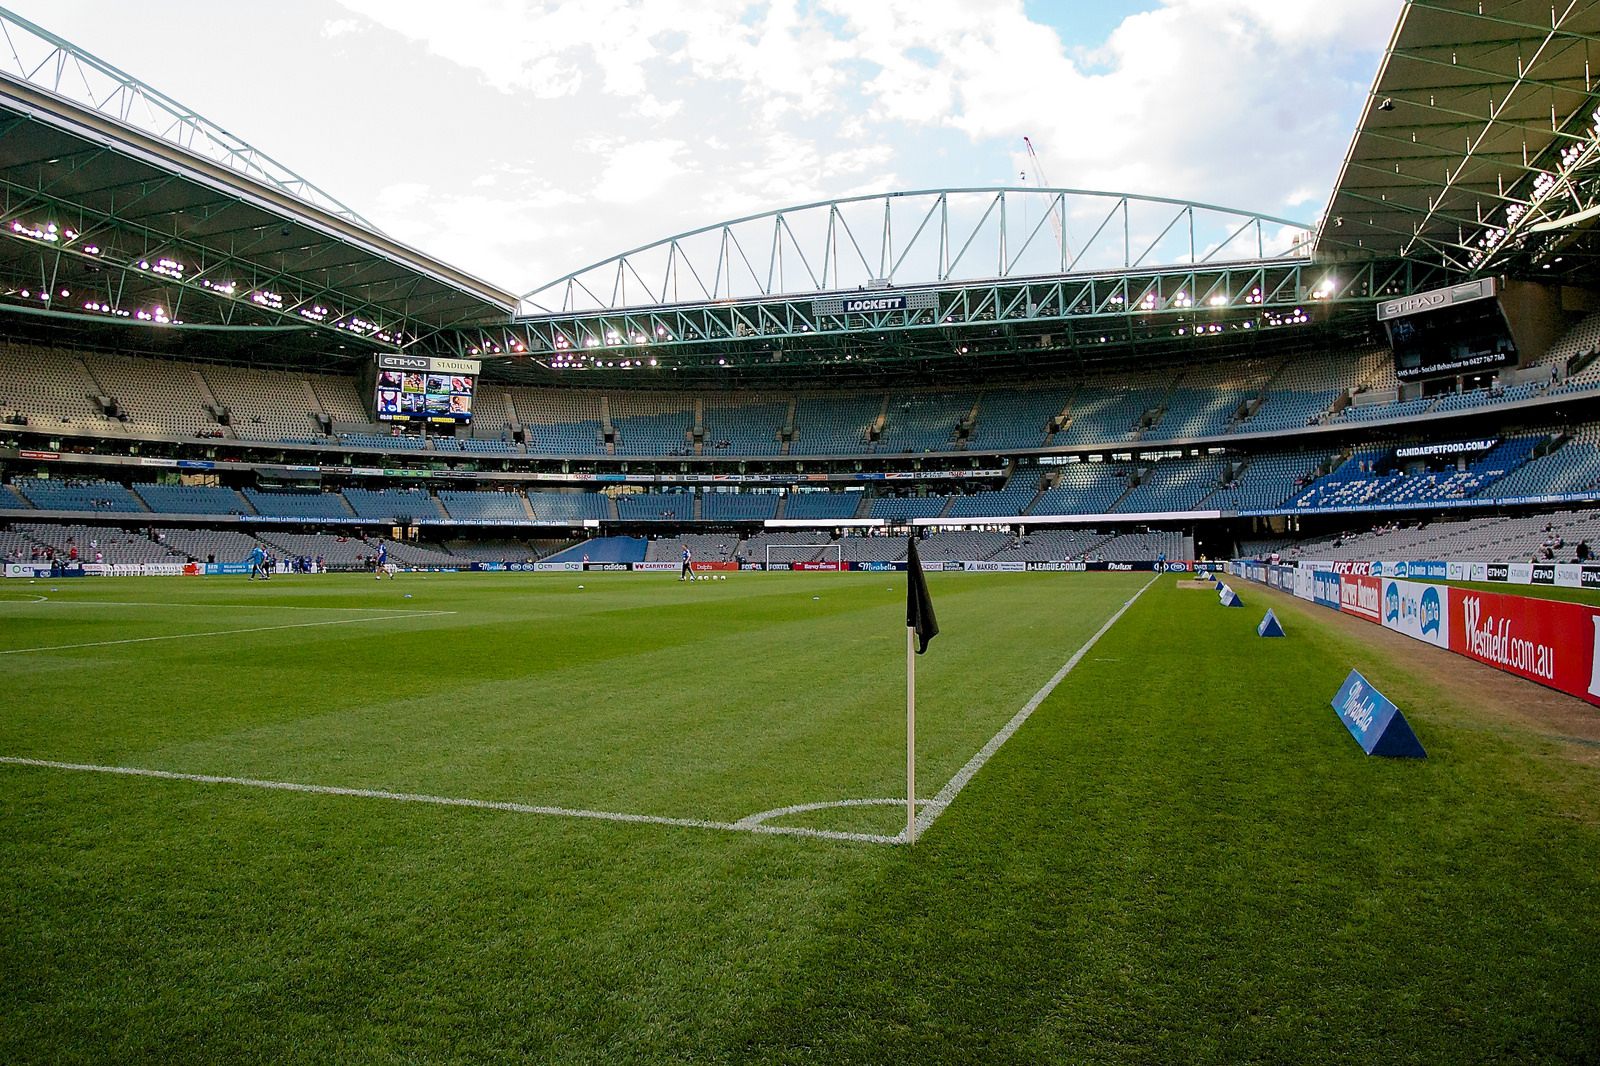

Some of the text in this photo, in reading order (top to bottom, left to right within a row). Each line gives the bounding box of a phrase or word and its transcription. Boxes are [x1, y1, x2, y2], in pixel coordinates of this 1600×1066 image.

[847, 298, 902, 311] LOCKETT
[1385, 294, 1445, 314] ETIHAD
[384, 358, 473, 370] ETIHAD STADIUM
[1422, 364, 1436, 373] Social
[858, 562, 896, 571] Mirabella
[1027, 562, 1086, 571] A-LEAGUE.COM.AU
[1108, 562, 1132, 570] Dulux
[1333, 562, 1351, 574] KFC
[1351, 562, 1369, 575] KFC
[1488, 568, 1508, 576] ETIHAD
[1533, 569, 1554, 579] ETIHAD
[1462, 596, 1553, 680] Westfield.com.au
